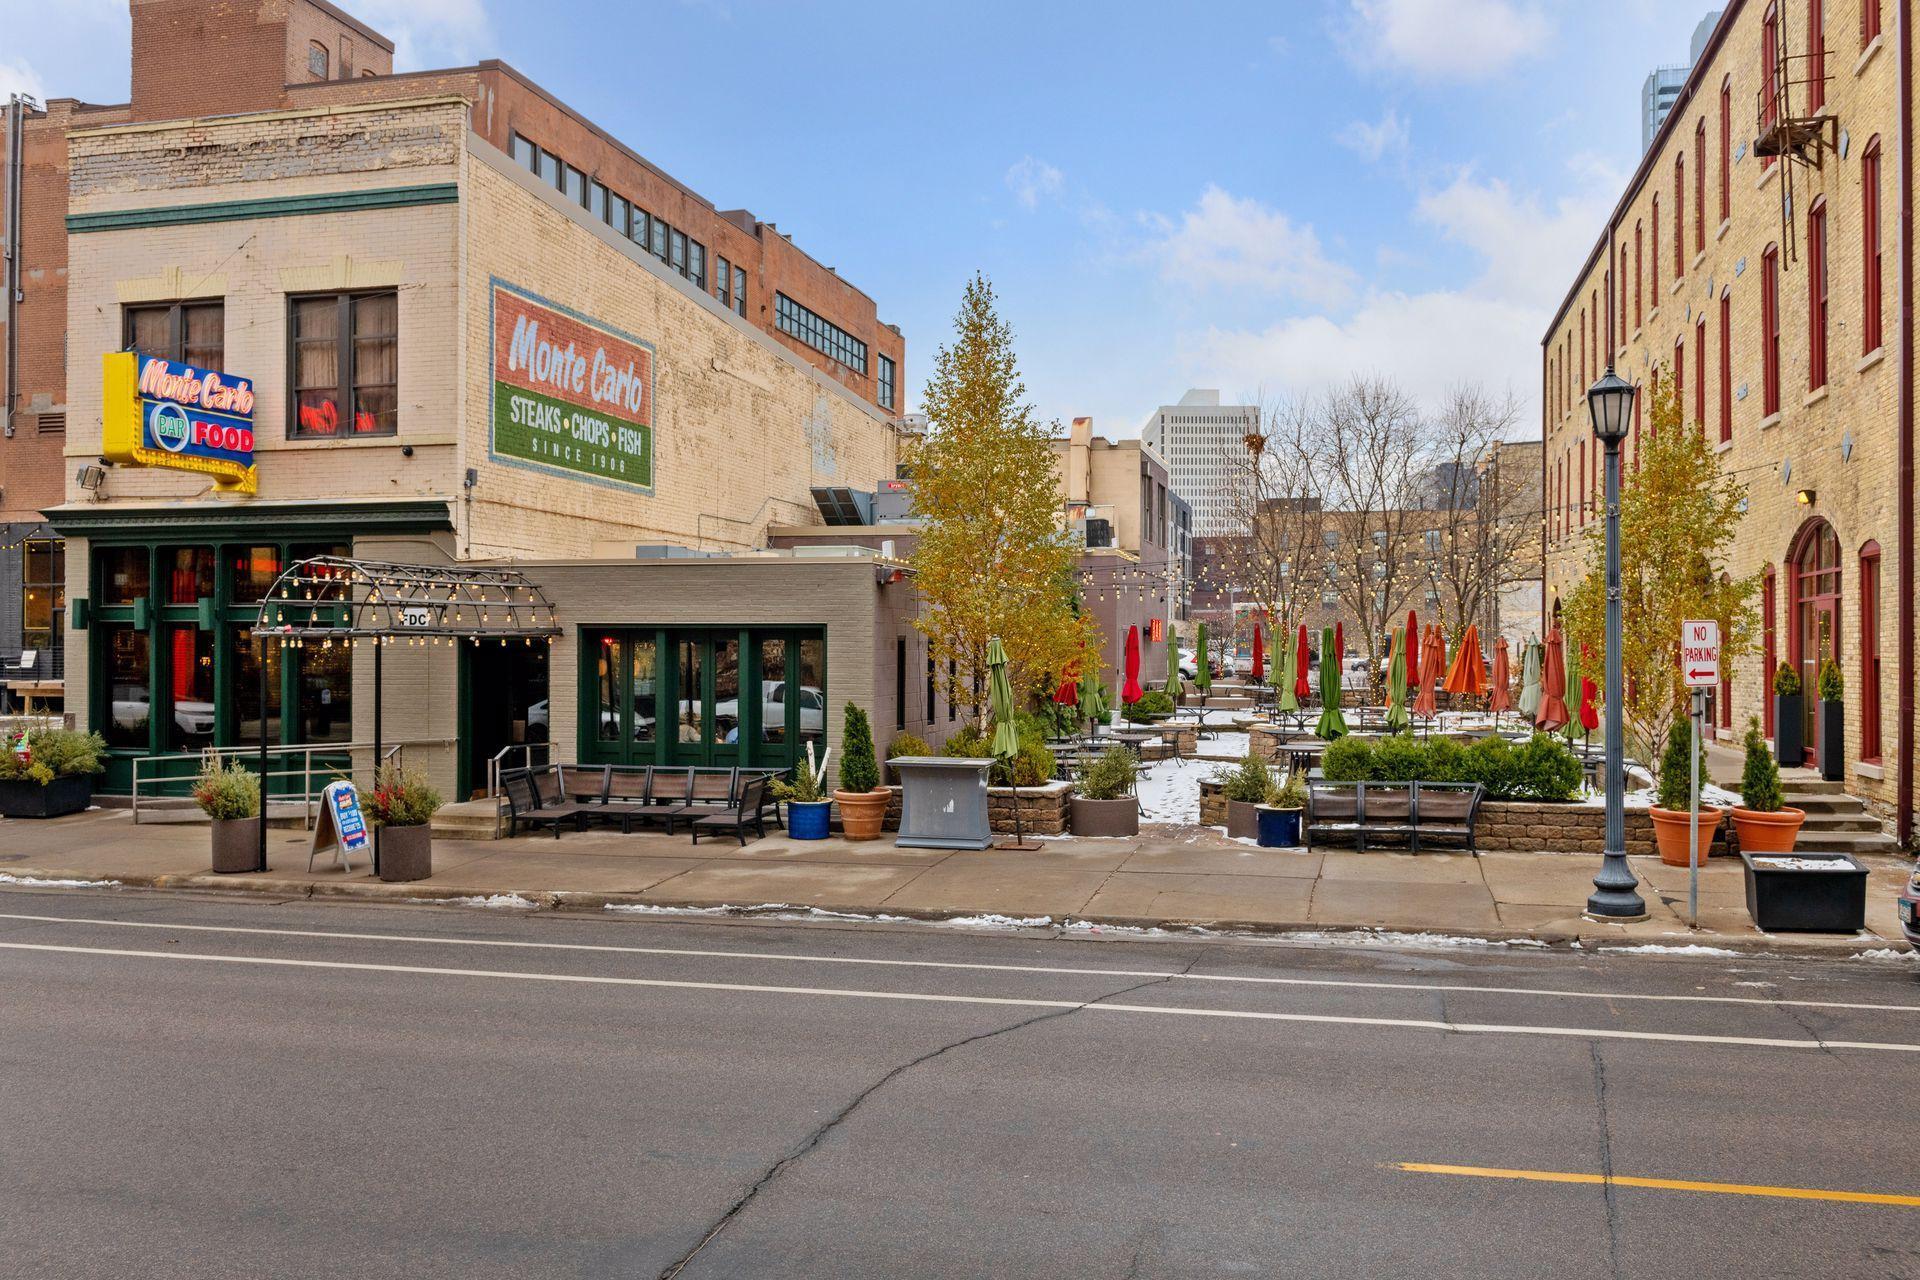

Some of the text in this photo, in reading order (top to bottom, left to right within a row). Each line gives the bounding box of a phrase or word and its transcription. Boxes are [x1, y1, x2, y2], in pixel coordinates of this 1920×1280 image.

[509, 314, 643, 414] Monte Carlo
[138, 359, 254, 415] Monte Carlo
[158, 415, 185, 438] BAR
[191, 421, 254, 452] FOOD
[510, 395, 642, 456] STEAKS CHOPS FISH
[532, 438, 625, 473] SINCE 1906
[403, 614, 426, 625] FDC
[1694, 626, 1707, 641] NO
[1685, 647, 1717, 662] PARKING
